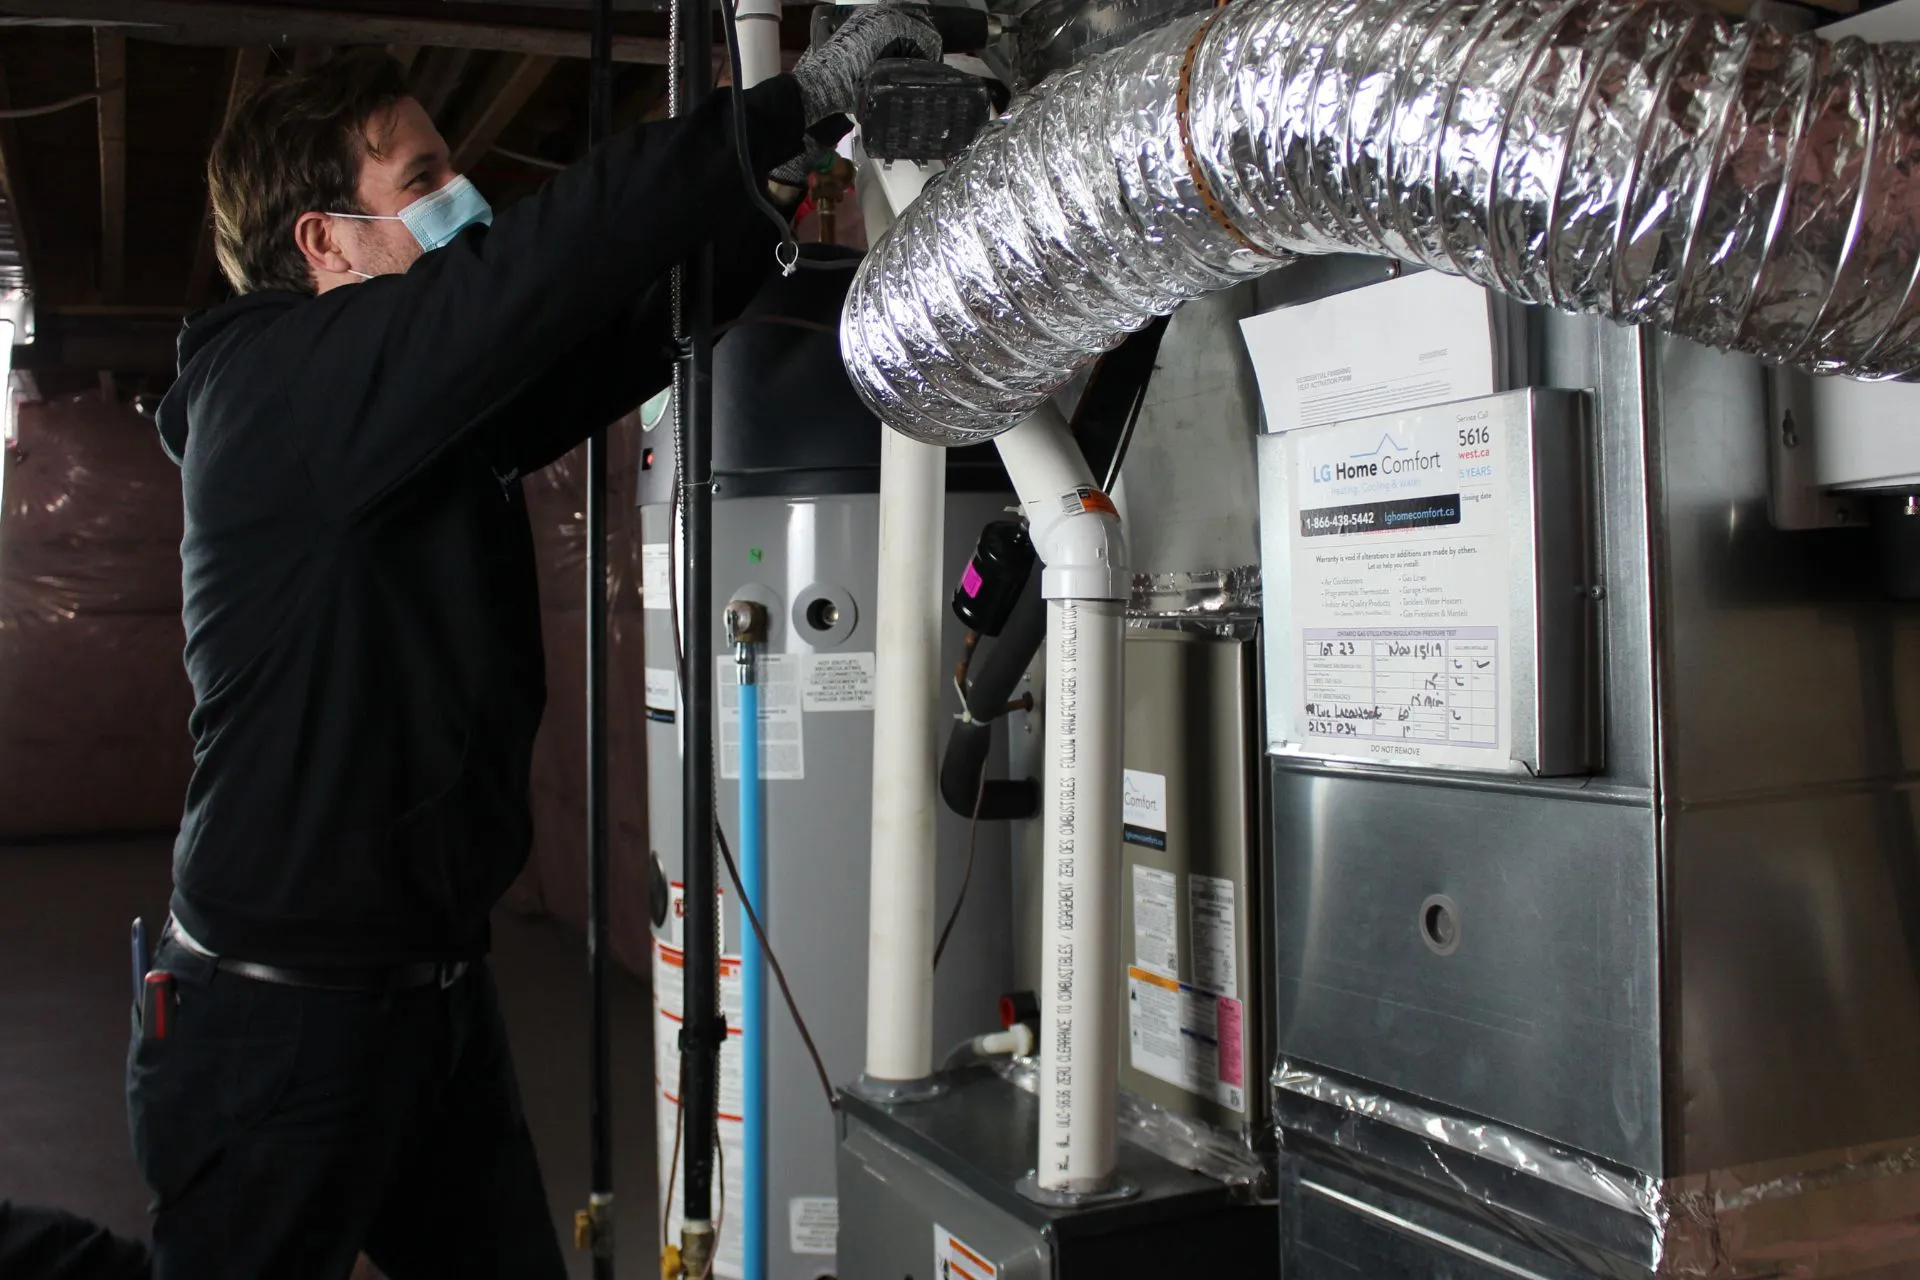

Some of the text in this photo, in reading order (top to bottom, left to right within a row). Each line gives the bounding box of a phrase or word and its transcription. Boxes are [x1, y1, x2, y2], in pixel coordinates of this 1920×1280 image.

[1477, 410, 1489, 420] Call
[1459, 426, 1490, 446] 5616
[1458, 448, 1490, 460] west.ca
[1313, 450, 1441, 483] LG Home Comfort
[1466, 466, 1492, 477] YEARS
[1480, 491, 1492, 499] date
[1306, 507, 1455, 529] 1-866-438-5442 lghomecomfort.ca
[1316, 555, 1339, 564] Warranty
[1357, 553, 1361, 561] if
[1361, 551, 1390, 560] alterations
[1397, 549, 1421, 559] additions
[1432, 547, 1448, 556] made
[1449, 547, 1456, 557] by
[1457, 546, 1477, 555] others.
[1368, 562, 1376, 570] Let
[1382, 562, 1393, 571] help
[1394, 562, 1403, 570] you
[1349, 600, 1367, 609] Quality
[1061, 604, 1079, 662] INSTALLATION
[1339, 641, 1355, 656] 23
[1060, 667, 1077, 736] MANUFACTURER'S
[1059, 739, 1076, 769] FOLLOW
[1371, 744, 1420, 756] DO NOT REMOVE
[1058, 777, 1076, 835] COMBUSTIBLES
[1125, 792, 1157, 810] Comfort
[1058, 839, 1075, 855] DES
[1058, 858, 1074, 878] ZERO
[1057, 943, 1074, 1001] COMBUSTIBLES
[1057, 1005, 1072, 1014] TO
[1056, 1019, 1073, 1063] CLEARANCE
[1056, 1066, 1072, 1086] ZERO
